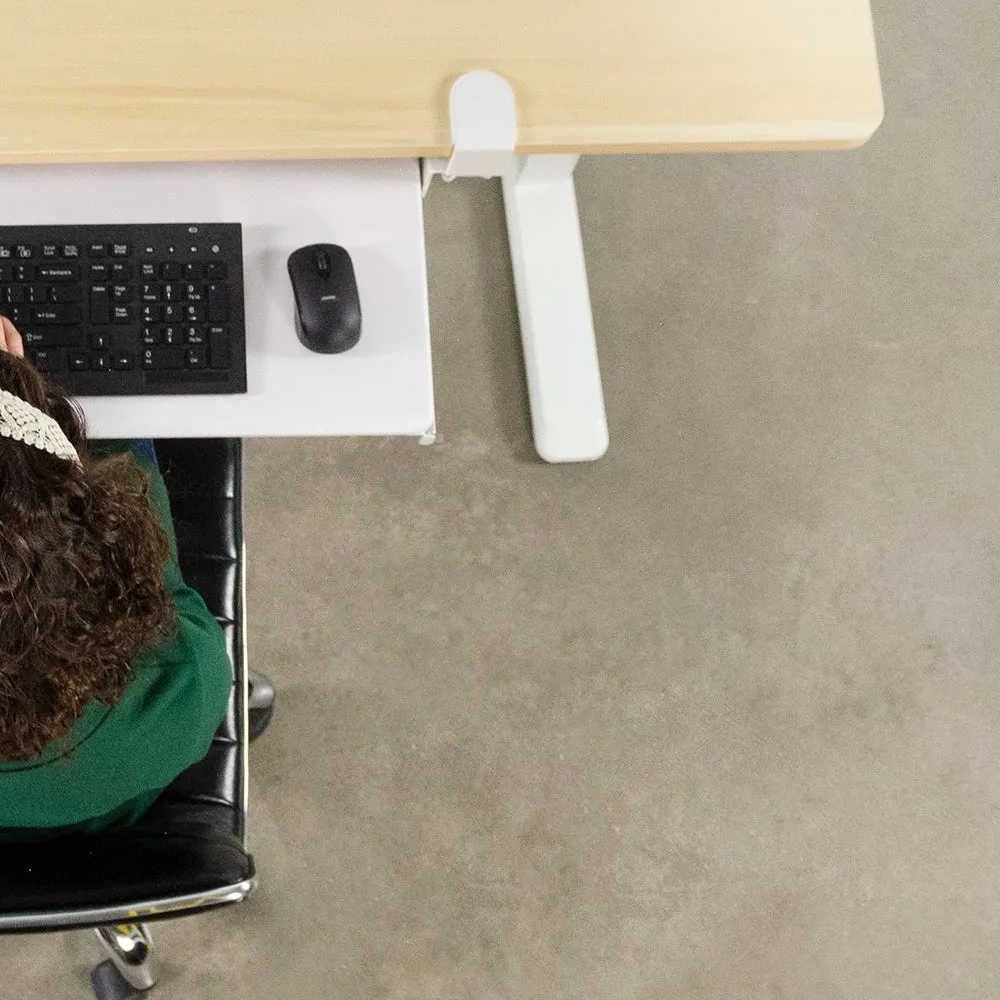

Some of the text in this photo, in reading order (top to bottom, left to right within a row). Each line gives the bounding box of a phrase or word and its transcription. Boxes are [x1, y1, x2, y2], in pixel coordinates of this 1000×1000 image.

[143, 285, 149, 293] 7
[144, 306, 150, 314] 4
[189, 328, 196, 336] 3
[145, 350, 152, 358] 0
